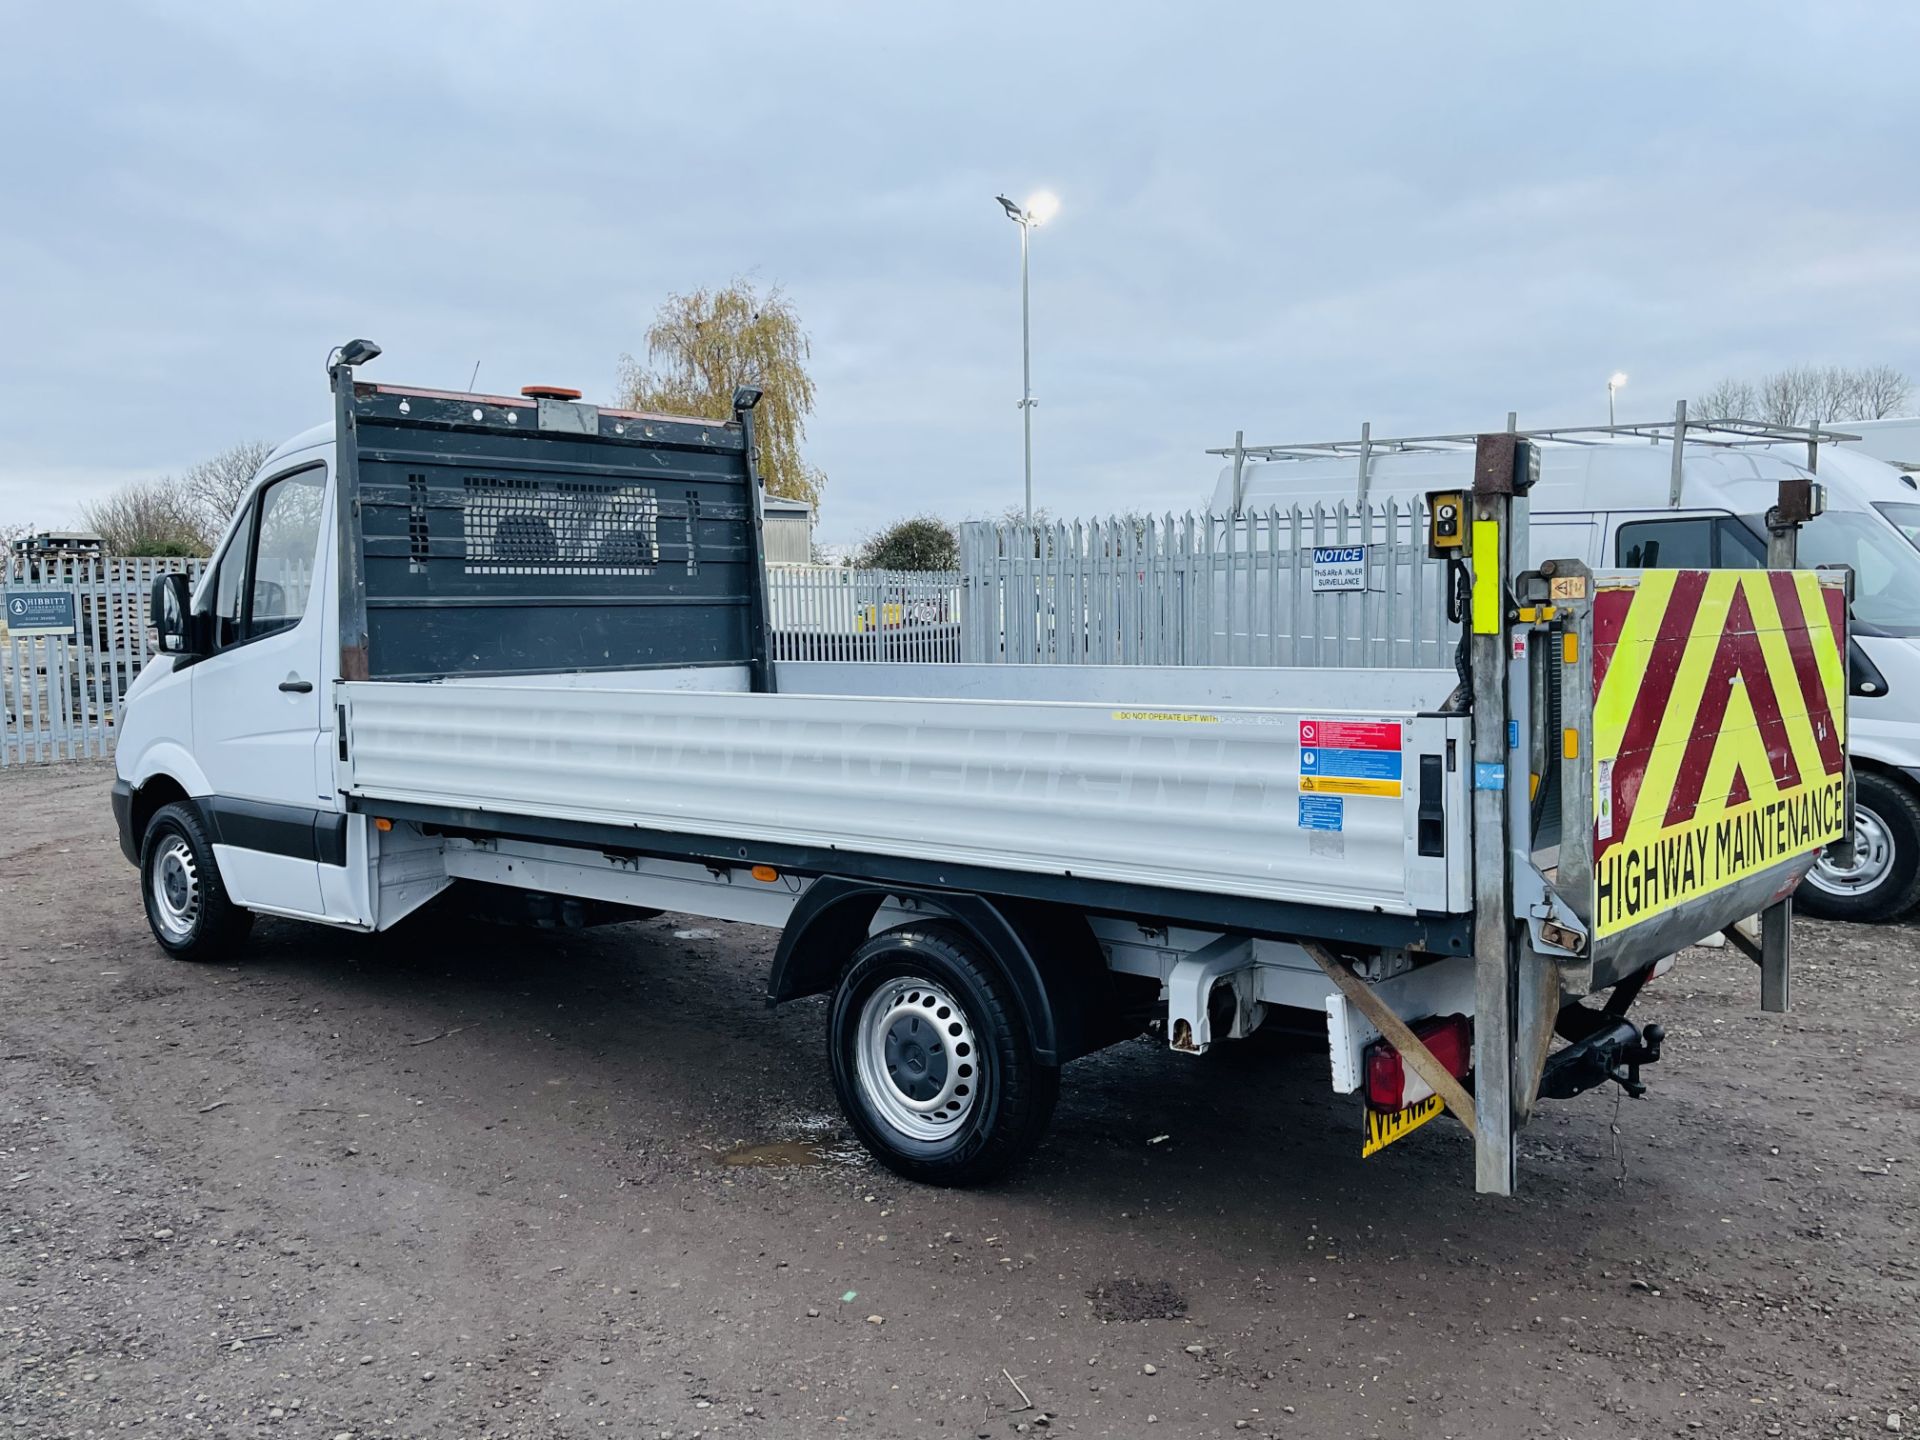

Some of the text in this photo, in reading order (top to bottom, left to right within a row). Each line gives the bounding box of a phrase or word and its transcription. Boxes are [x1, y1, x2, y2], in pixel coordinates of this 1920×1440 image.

[1315, 548, 1361, 562] NOTICE
[1327, 568, 1342, 576] AREA
[1318, 578, 1360, 586] SURVEILLANCE
[1120, 711, 1130, 720] DO
[1132, 712, 1147, 720] NOT
[1149, 712, 1181, 721] OPERATE
[1183, 713, 1198, 721] LIFT
[1200, 714, 1216, 722] WITH
[1597, 781, 1842, 928] HIGHWAY MAINTENANCE
